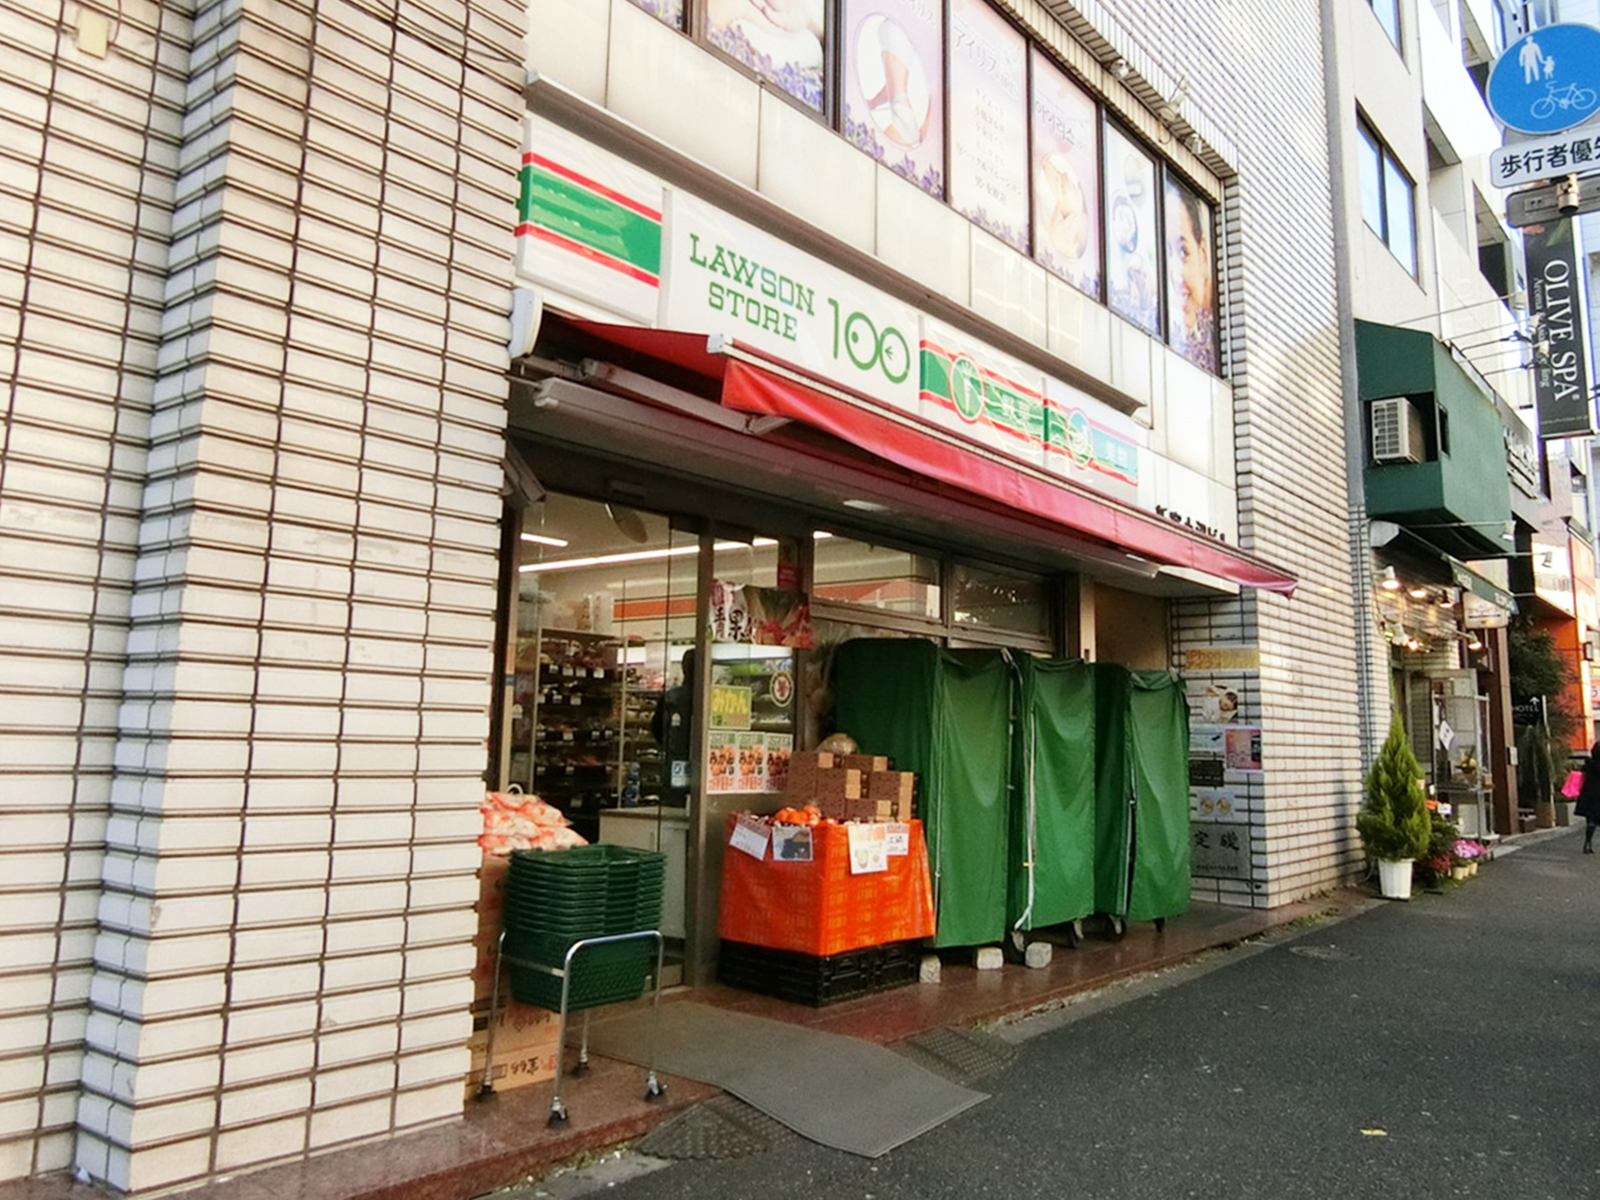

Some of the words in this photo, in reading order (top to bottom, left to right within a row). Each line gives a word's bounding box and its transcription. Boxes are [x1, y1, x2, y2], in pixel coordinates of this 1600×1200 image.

[690, 233, 814, 317] LAWSON
[708, 281, 798, 342] STORE
[1543, 258, 1574, 346] OLIVE
[828, 298, 911, 384] 100
[1551, 351, 1580, 402] SPA
